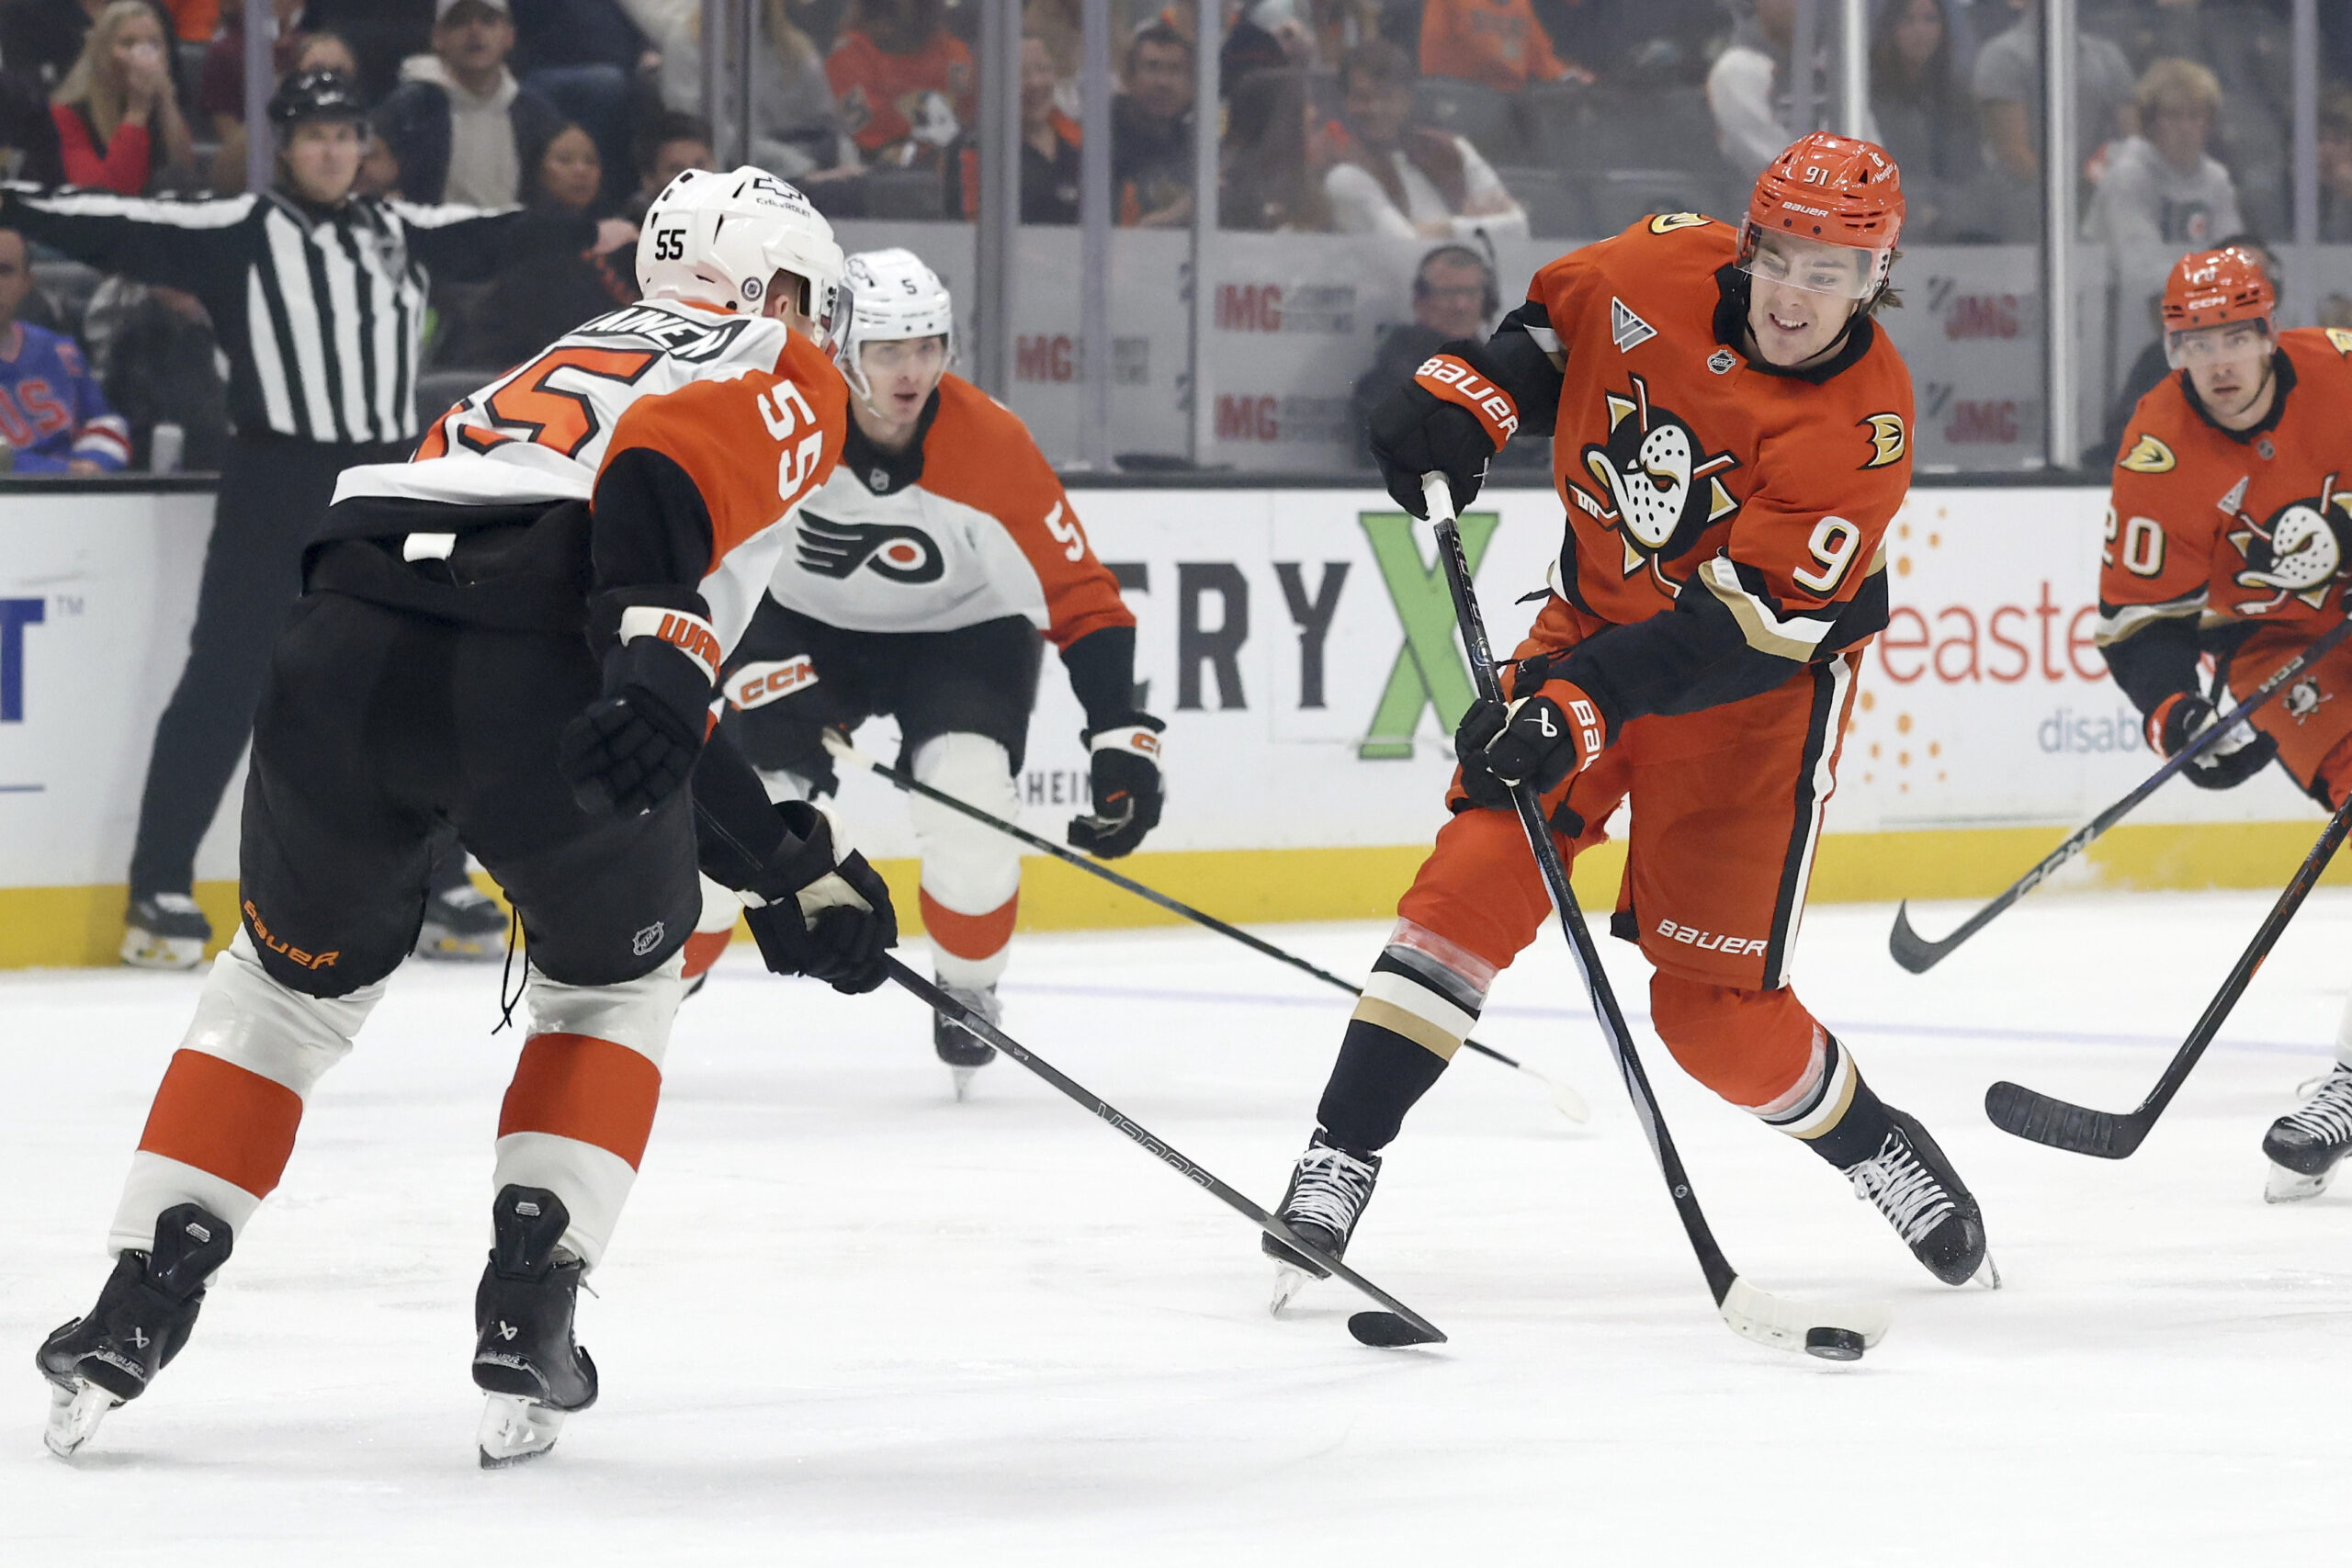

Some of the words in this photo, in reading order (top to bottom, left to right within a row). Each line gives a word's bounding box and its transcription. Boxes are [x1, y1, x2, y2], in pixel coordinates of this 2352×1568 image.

[1804, 166, 1829, 186] 91
[655, 230, 686, 261] 55
[902, 278, 918, 296] 5
[582, 307, 732, 358] AINEN
[1044, 499, 1085, 562] 5
